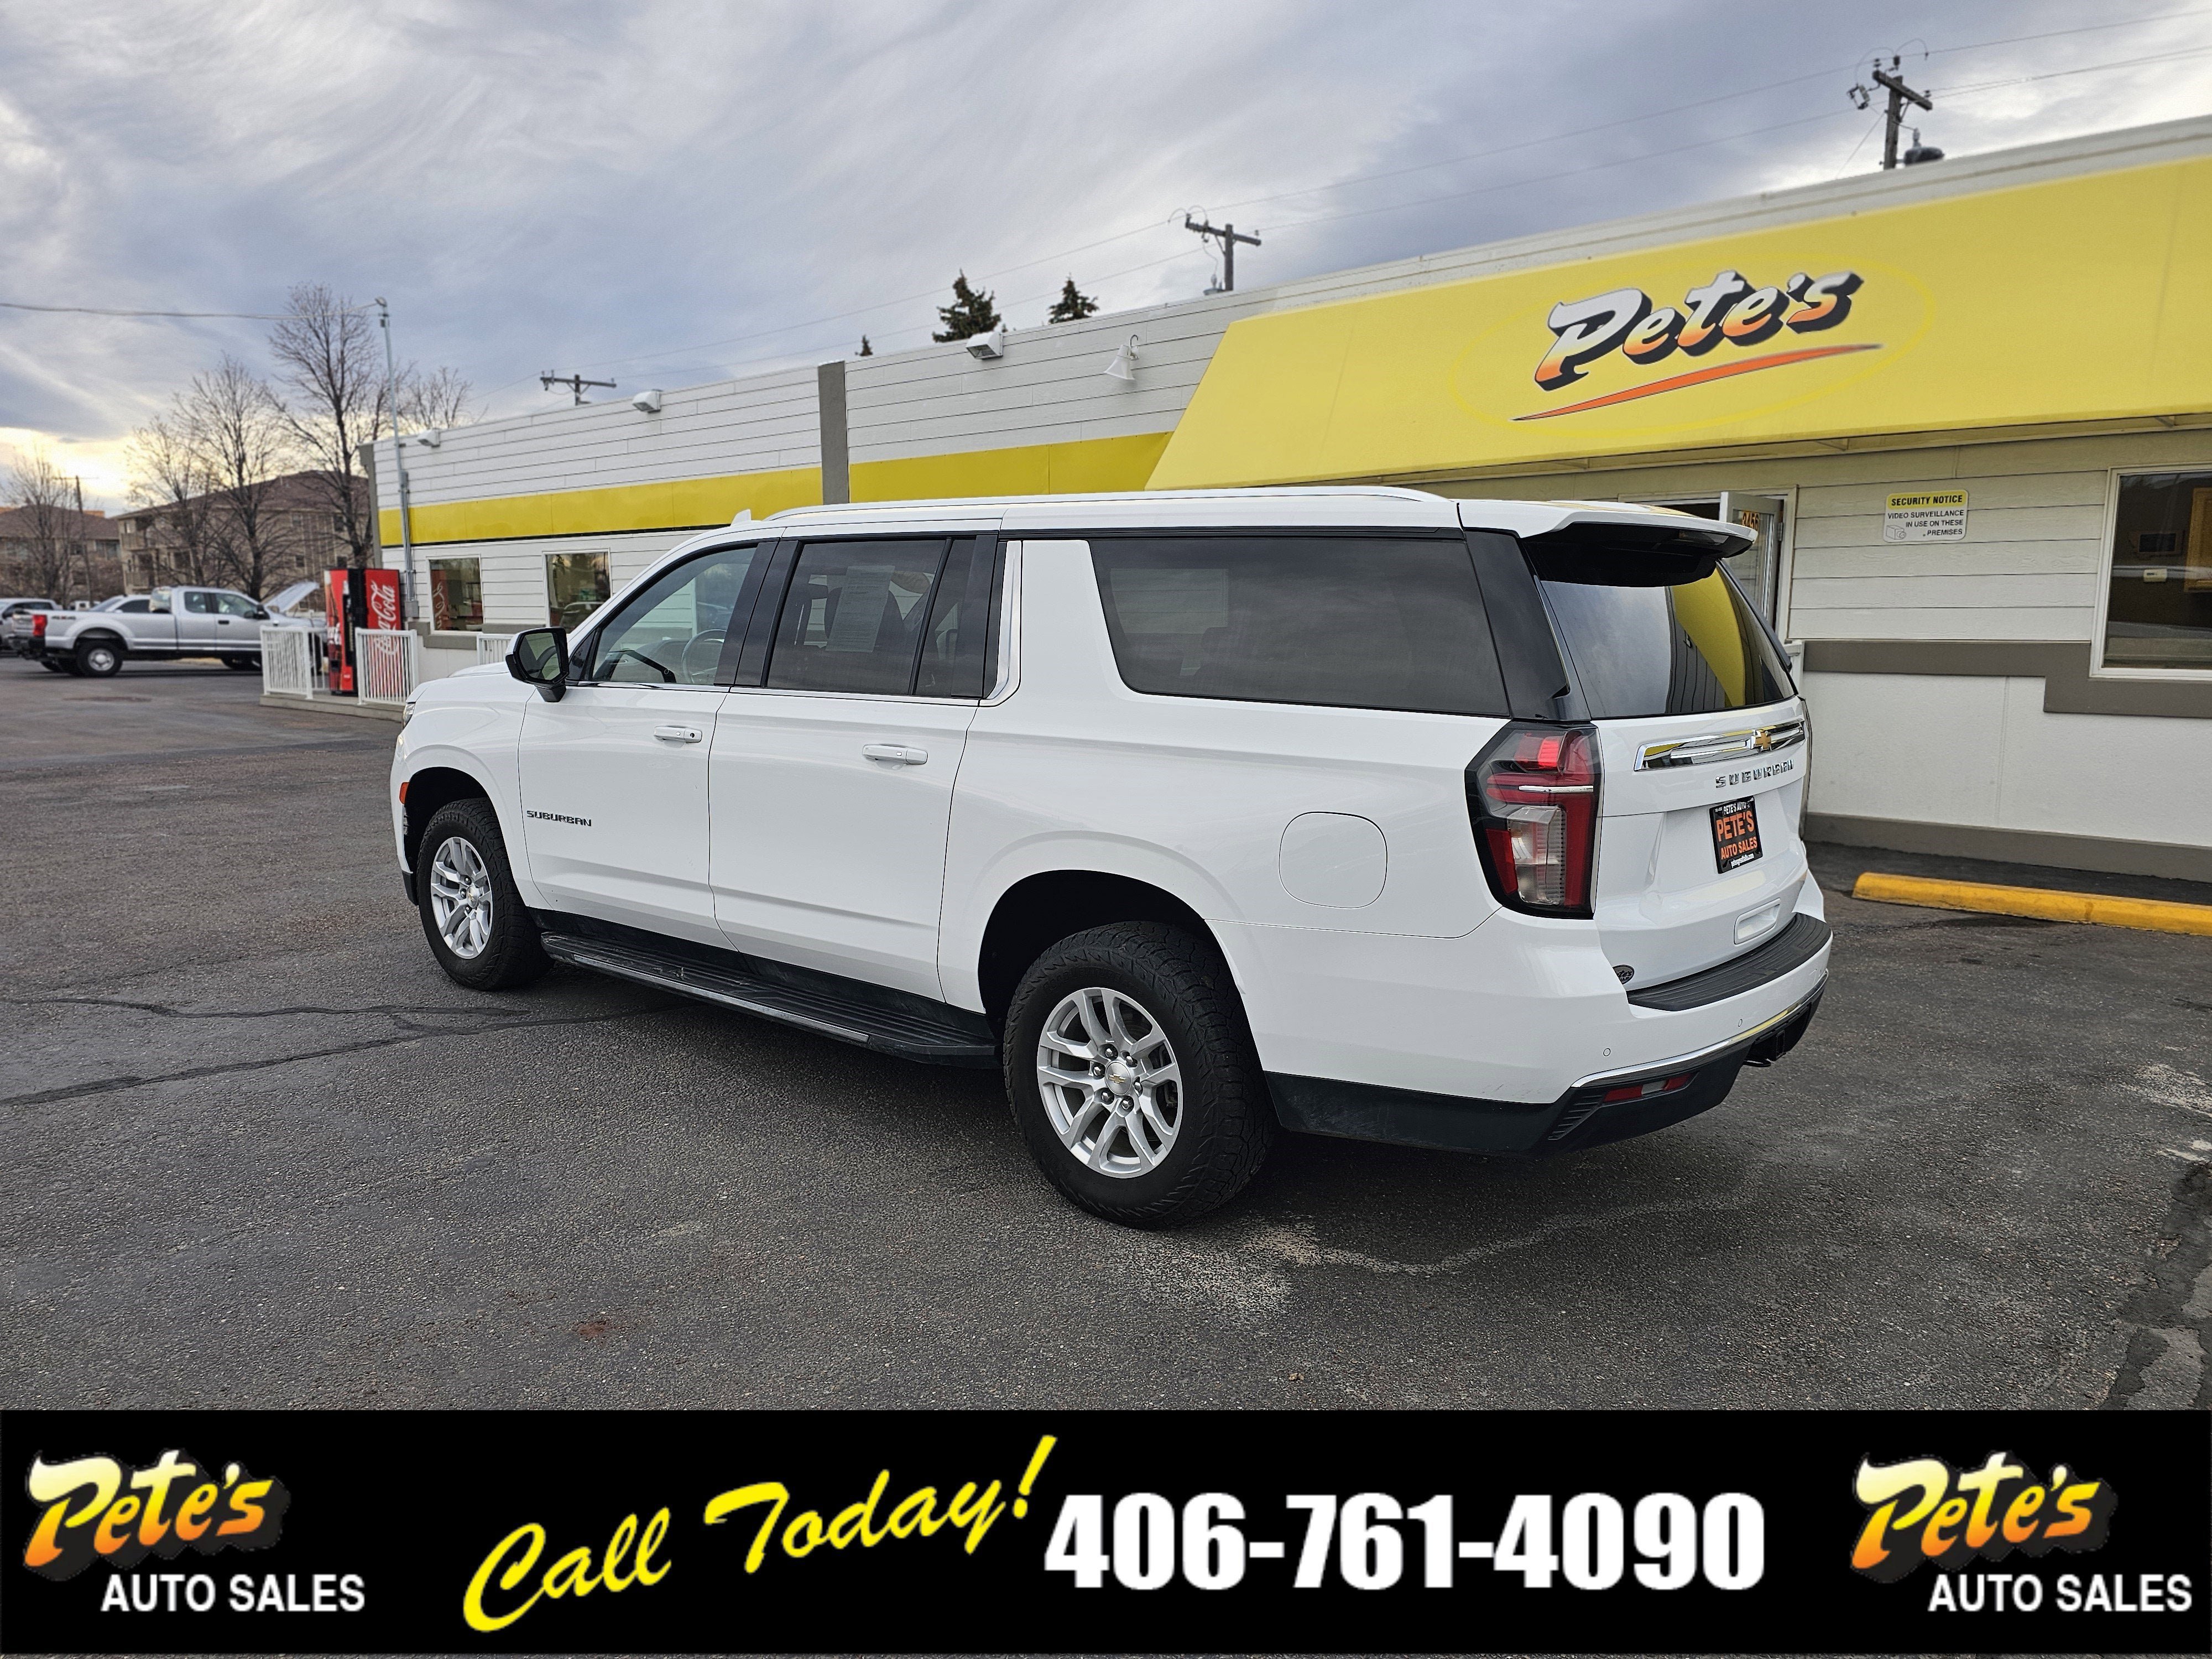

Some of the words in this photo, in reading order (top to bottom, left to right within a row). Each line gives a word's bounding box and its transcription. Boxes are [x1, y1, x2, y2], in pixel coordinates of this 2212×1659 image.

[1534, 269, 1864, 391] Pete's
[1891, 497, 1931, 506] SECURITY
[1933, 495, 1963, 504] NOTICE
[1911, 510, 1964, 518] SURVEILLANCE
[1723, 802, 1736, 815] PETE'S
[1737, 802, 1747, 811] AUTO
[526, 810, 592, 827] SUBURBAN
[1716, 810, 1755, 842] PETE'S
[1721, 843, 1738, 859] AUTO
[1738, 836, 1758, 853] SALES
